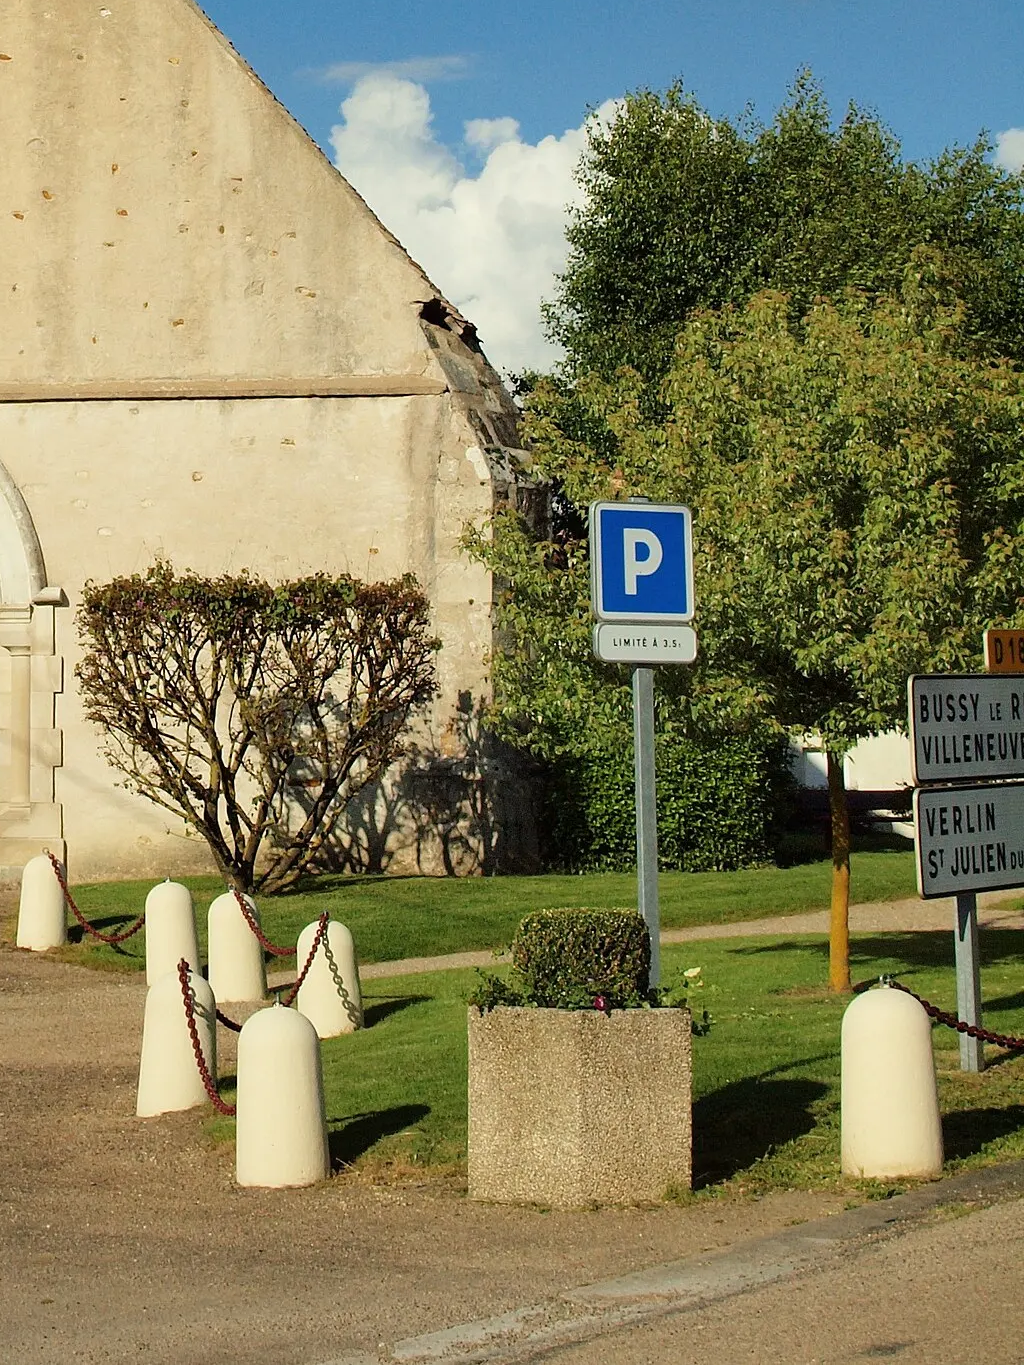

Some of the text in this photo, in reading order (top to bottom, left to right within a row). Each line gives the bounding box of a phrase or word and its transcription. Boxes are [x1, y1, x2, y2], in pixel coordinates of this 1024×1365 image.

[623, 527, 663, 596] P
[613, 637, 647, 648] LIMITÉ
[920, 692, 1024, 723] BUSSY LE R
[926, 802, 996, 837] VERLIN
[950, 842, 1006, 877] JULIEN
[1010, 849, 1024, 870] DU
